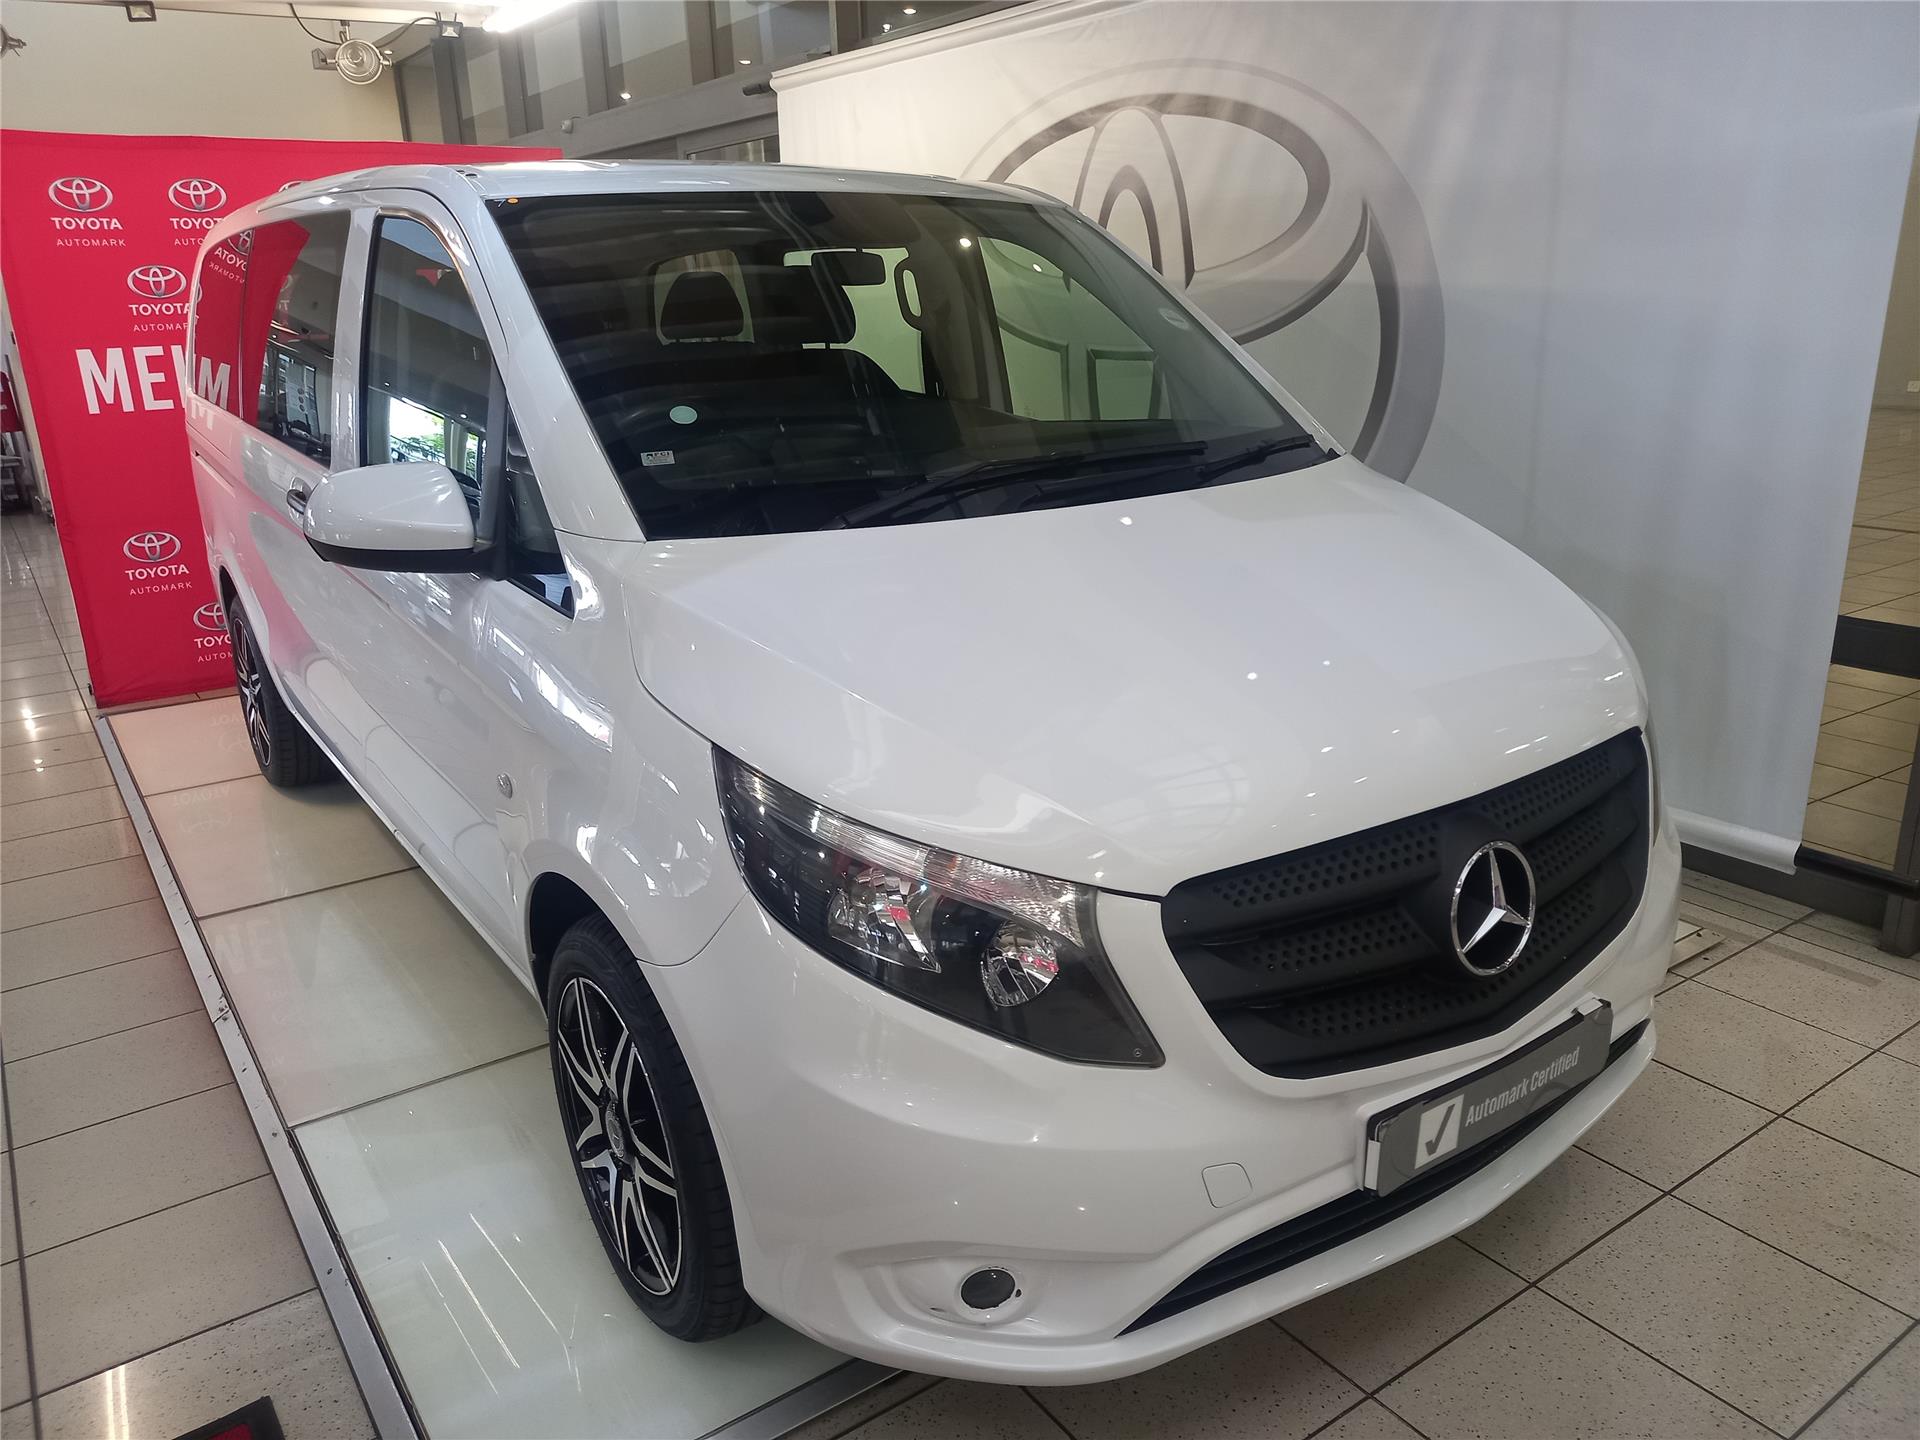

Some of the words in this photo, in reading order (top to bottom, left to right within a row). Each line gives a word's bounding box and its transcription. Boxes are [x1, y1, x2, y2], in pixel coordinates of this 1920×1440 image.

[51, 217, 123, 230] TOYOTA
[170, 218, 224, 230] TOYOT
[56, 238, 126, 247] AUTOMARK
[125, 564, 189, 581] TOYOTA
[129, 581, 193, 596] AUTOMARK
[193, 634, 232, 649] TOYO
[1465, 1077, 1530, 1128] Automark
[1530, 1046, 1581, 1093] Certified
